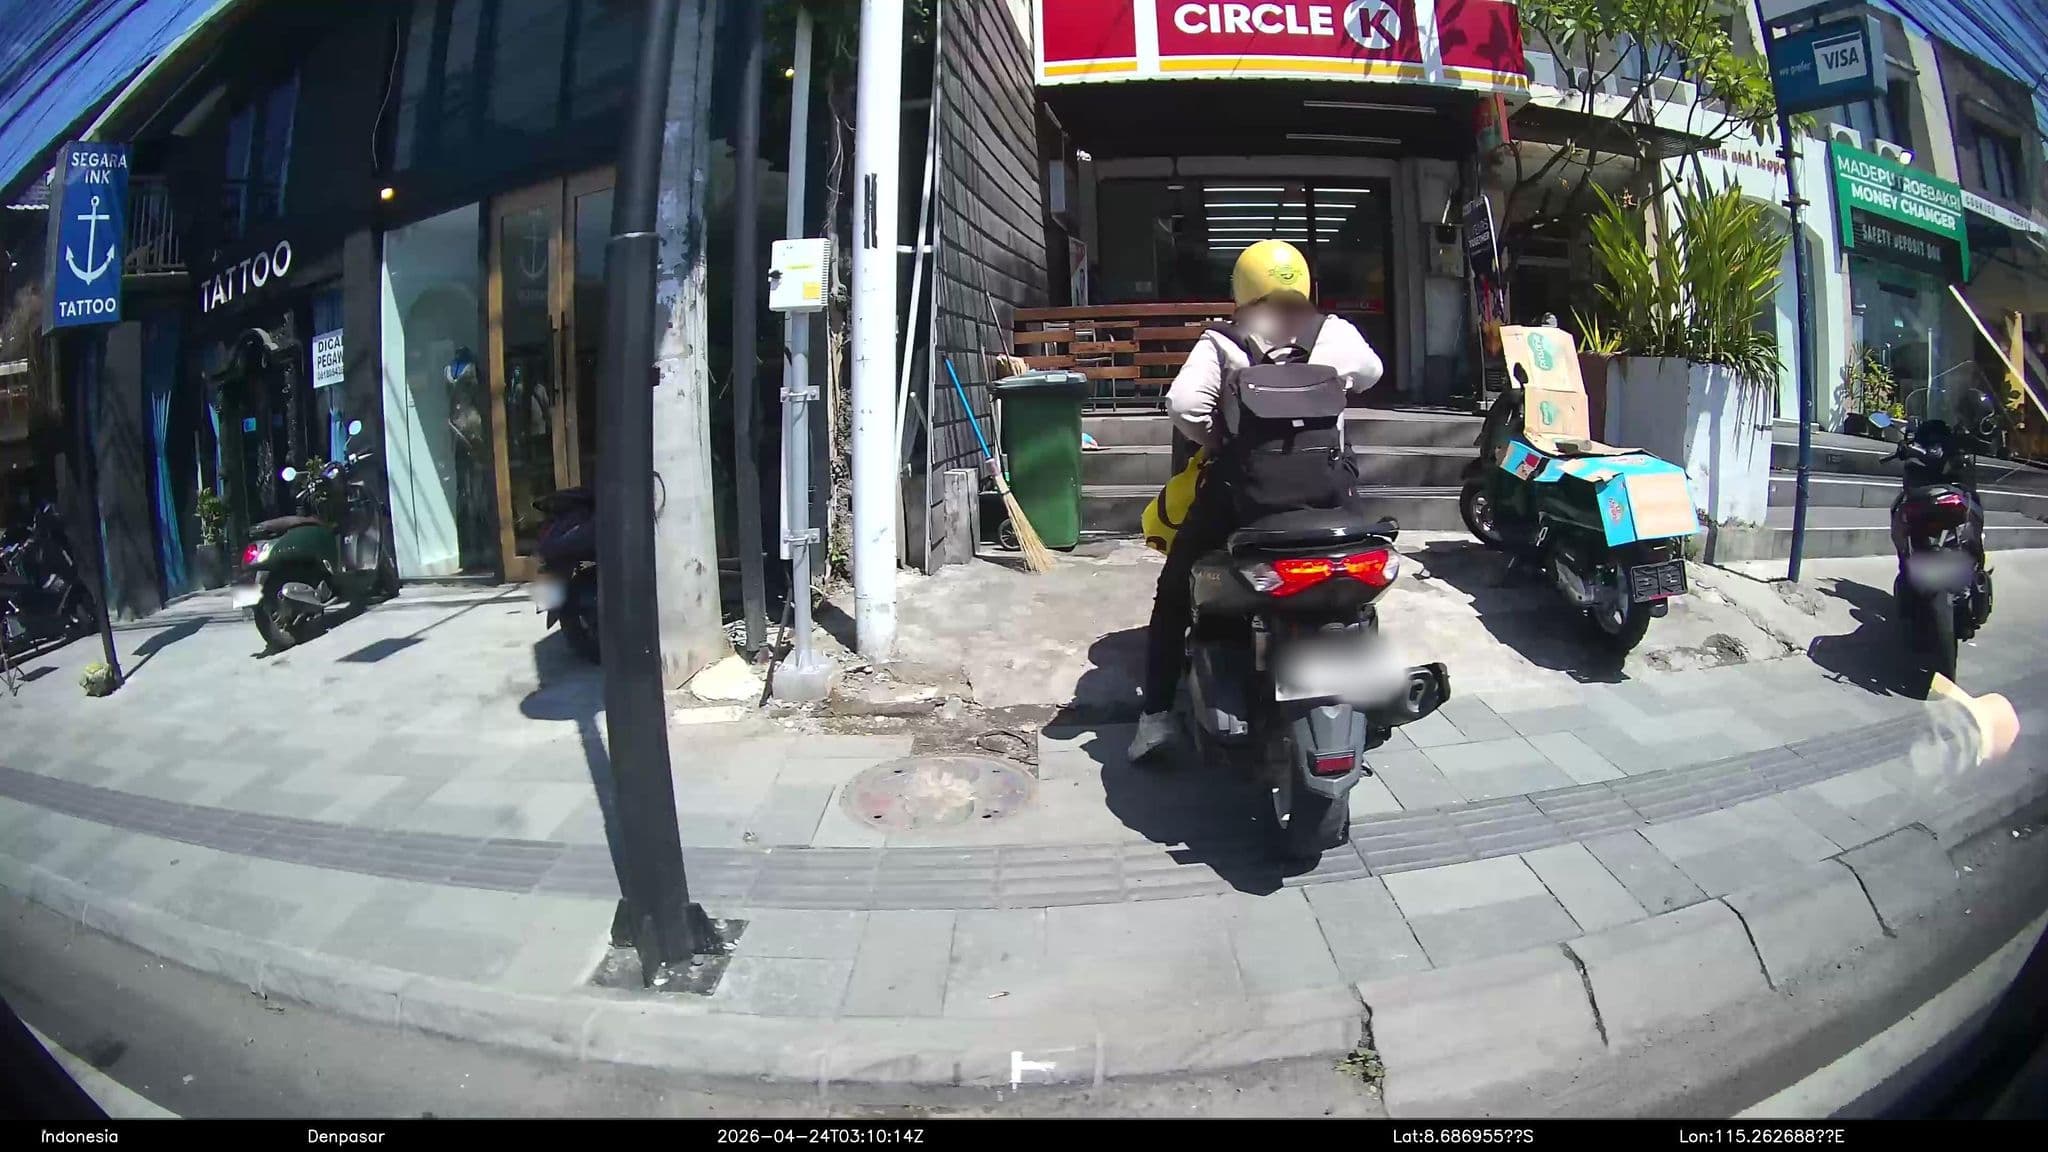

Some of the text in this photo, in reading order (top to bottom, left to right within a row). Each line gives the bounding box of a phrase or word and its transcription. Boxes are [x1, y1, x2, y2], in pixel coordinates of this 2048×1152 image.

[1173, 3, 1397, 47] CIRCLE K
[1822, 46, 1859, 70] VISA
[71, 151, 127, 169] SEGARA
[1731, 149, 1752, 167] and
[85, 170, 110, 185] INK
[1851, 183, 1956, 231] MONEY CHANGER
[1862, 224, 1891, 248] SAFETY
[1894, 234, 1925, 258] DEPOSIT
[201, 240, 292, 313] TATTOO
[59, 297, 116, 318] TATTOO
[318, 336, 344, 353] DICA
